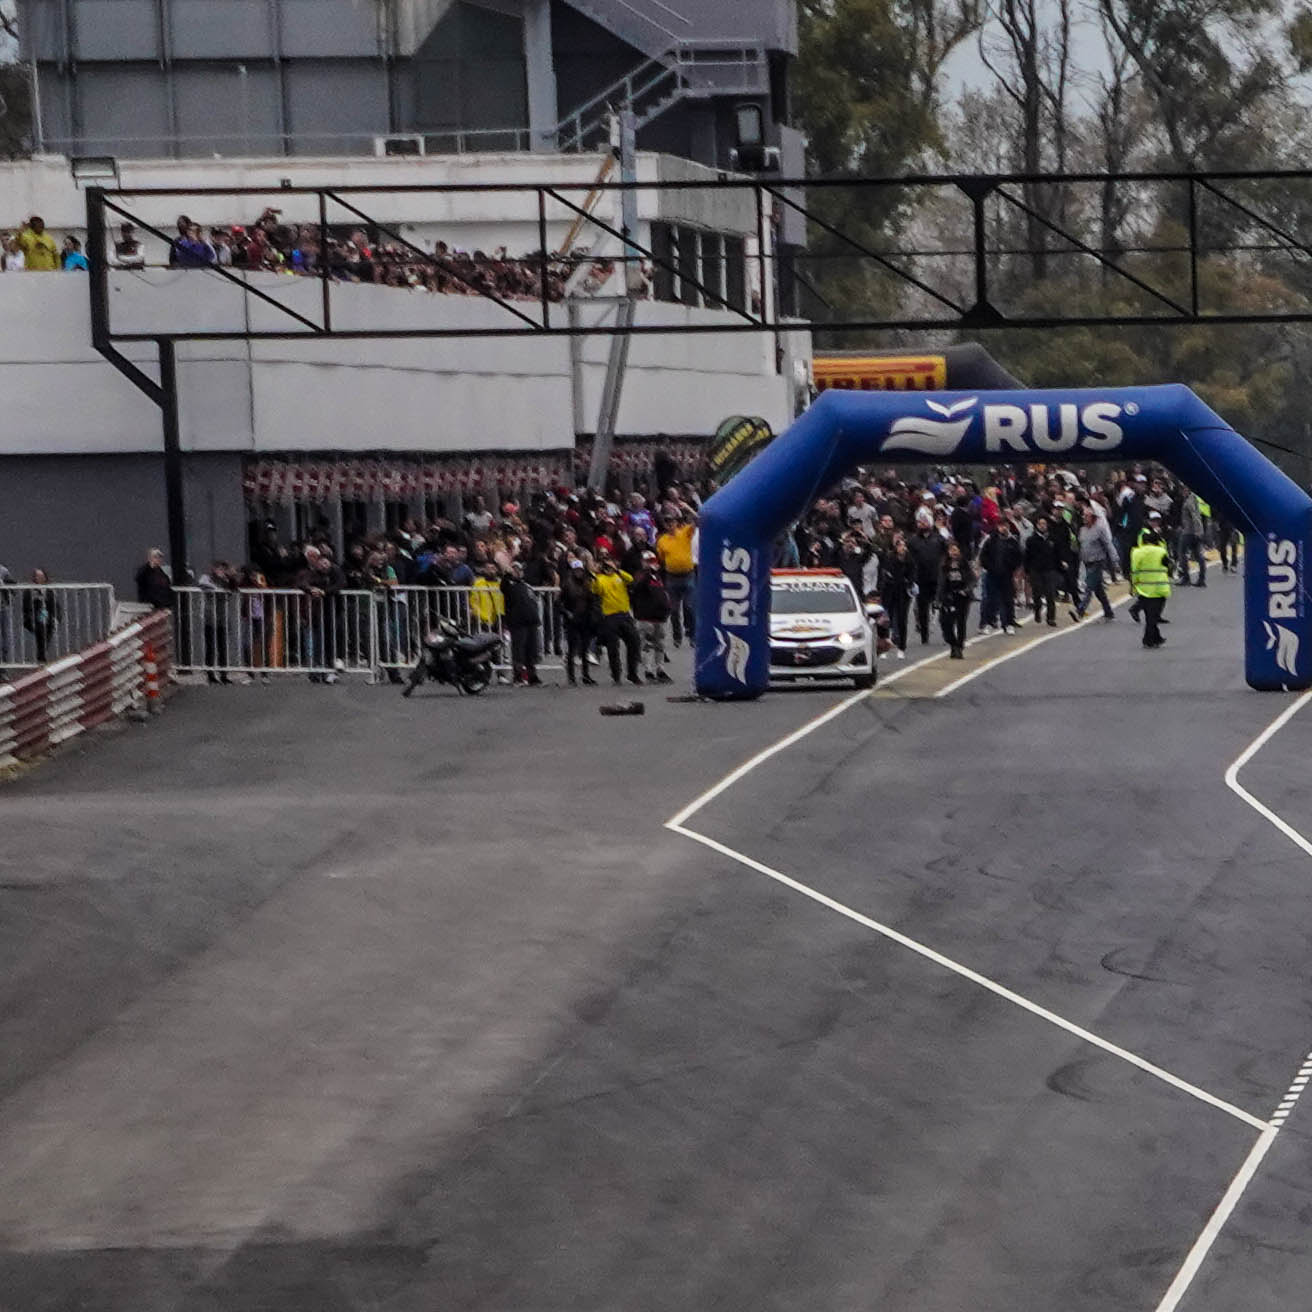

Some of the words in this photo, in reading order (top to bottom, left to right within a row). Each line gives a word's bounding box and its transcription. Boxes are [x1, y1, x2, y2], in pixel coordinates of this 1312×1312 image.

[983, 403, 1124, 452] RUS
[720, 546, 751, 627] RUS
[1268, 539, 1298, 619] RUS
